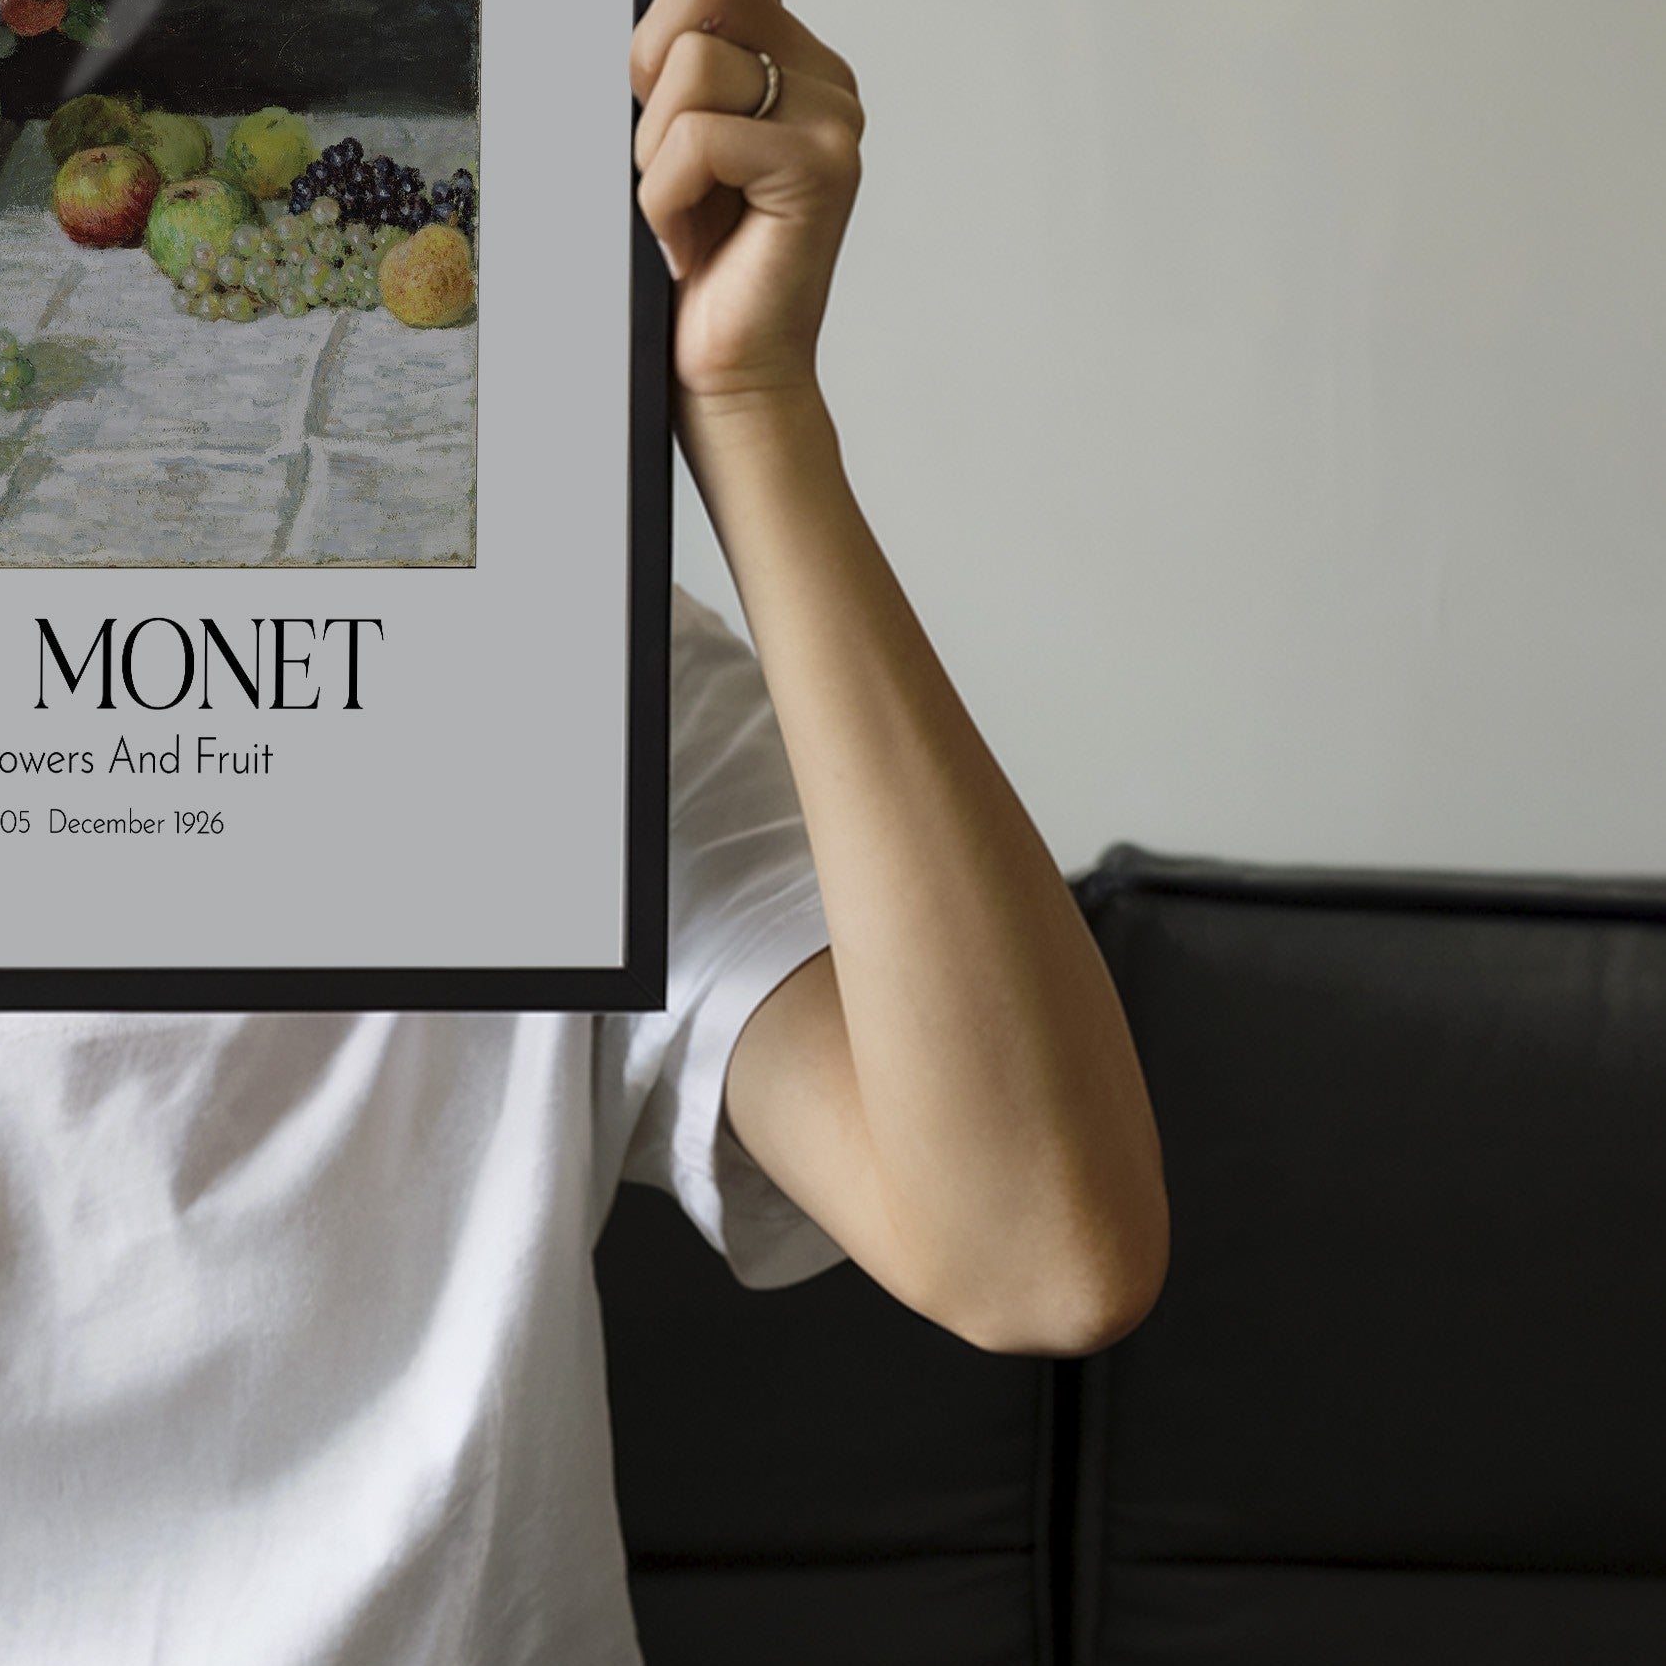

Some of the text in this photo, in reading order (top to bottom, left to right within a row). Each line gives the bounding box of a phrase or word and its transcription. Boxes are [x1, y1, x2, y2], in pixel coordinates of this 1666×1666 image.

[33, 617, 385, 711] MONET
[108, 733, 180, 775] And
[197, 735, 274, 775] Fruit
[0, 809, 31, 834] 05
[49, 807, 166, 835] December
[173, 810, 225, 835] 1926
